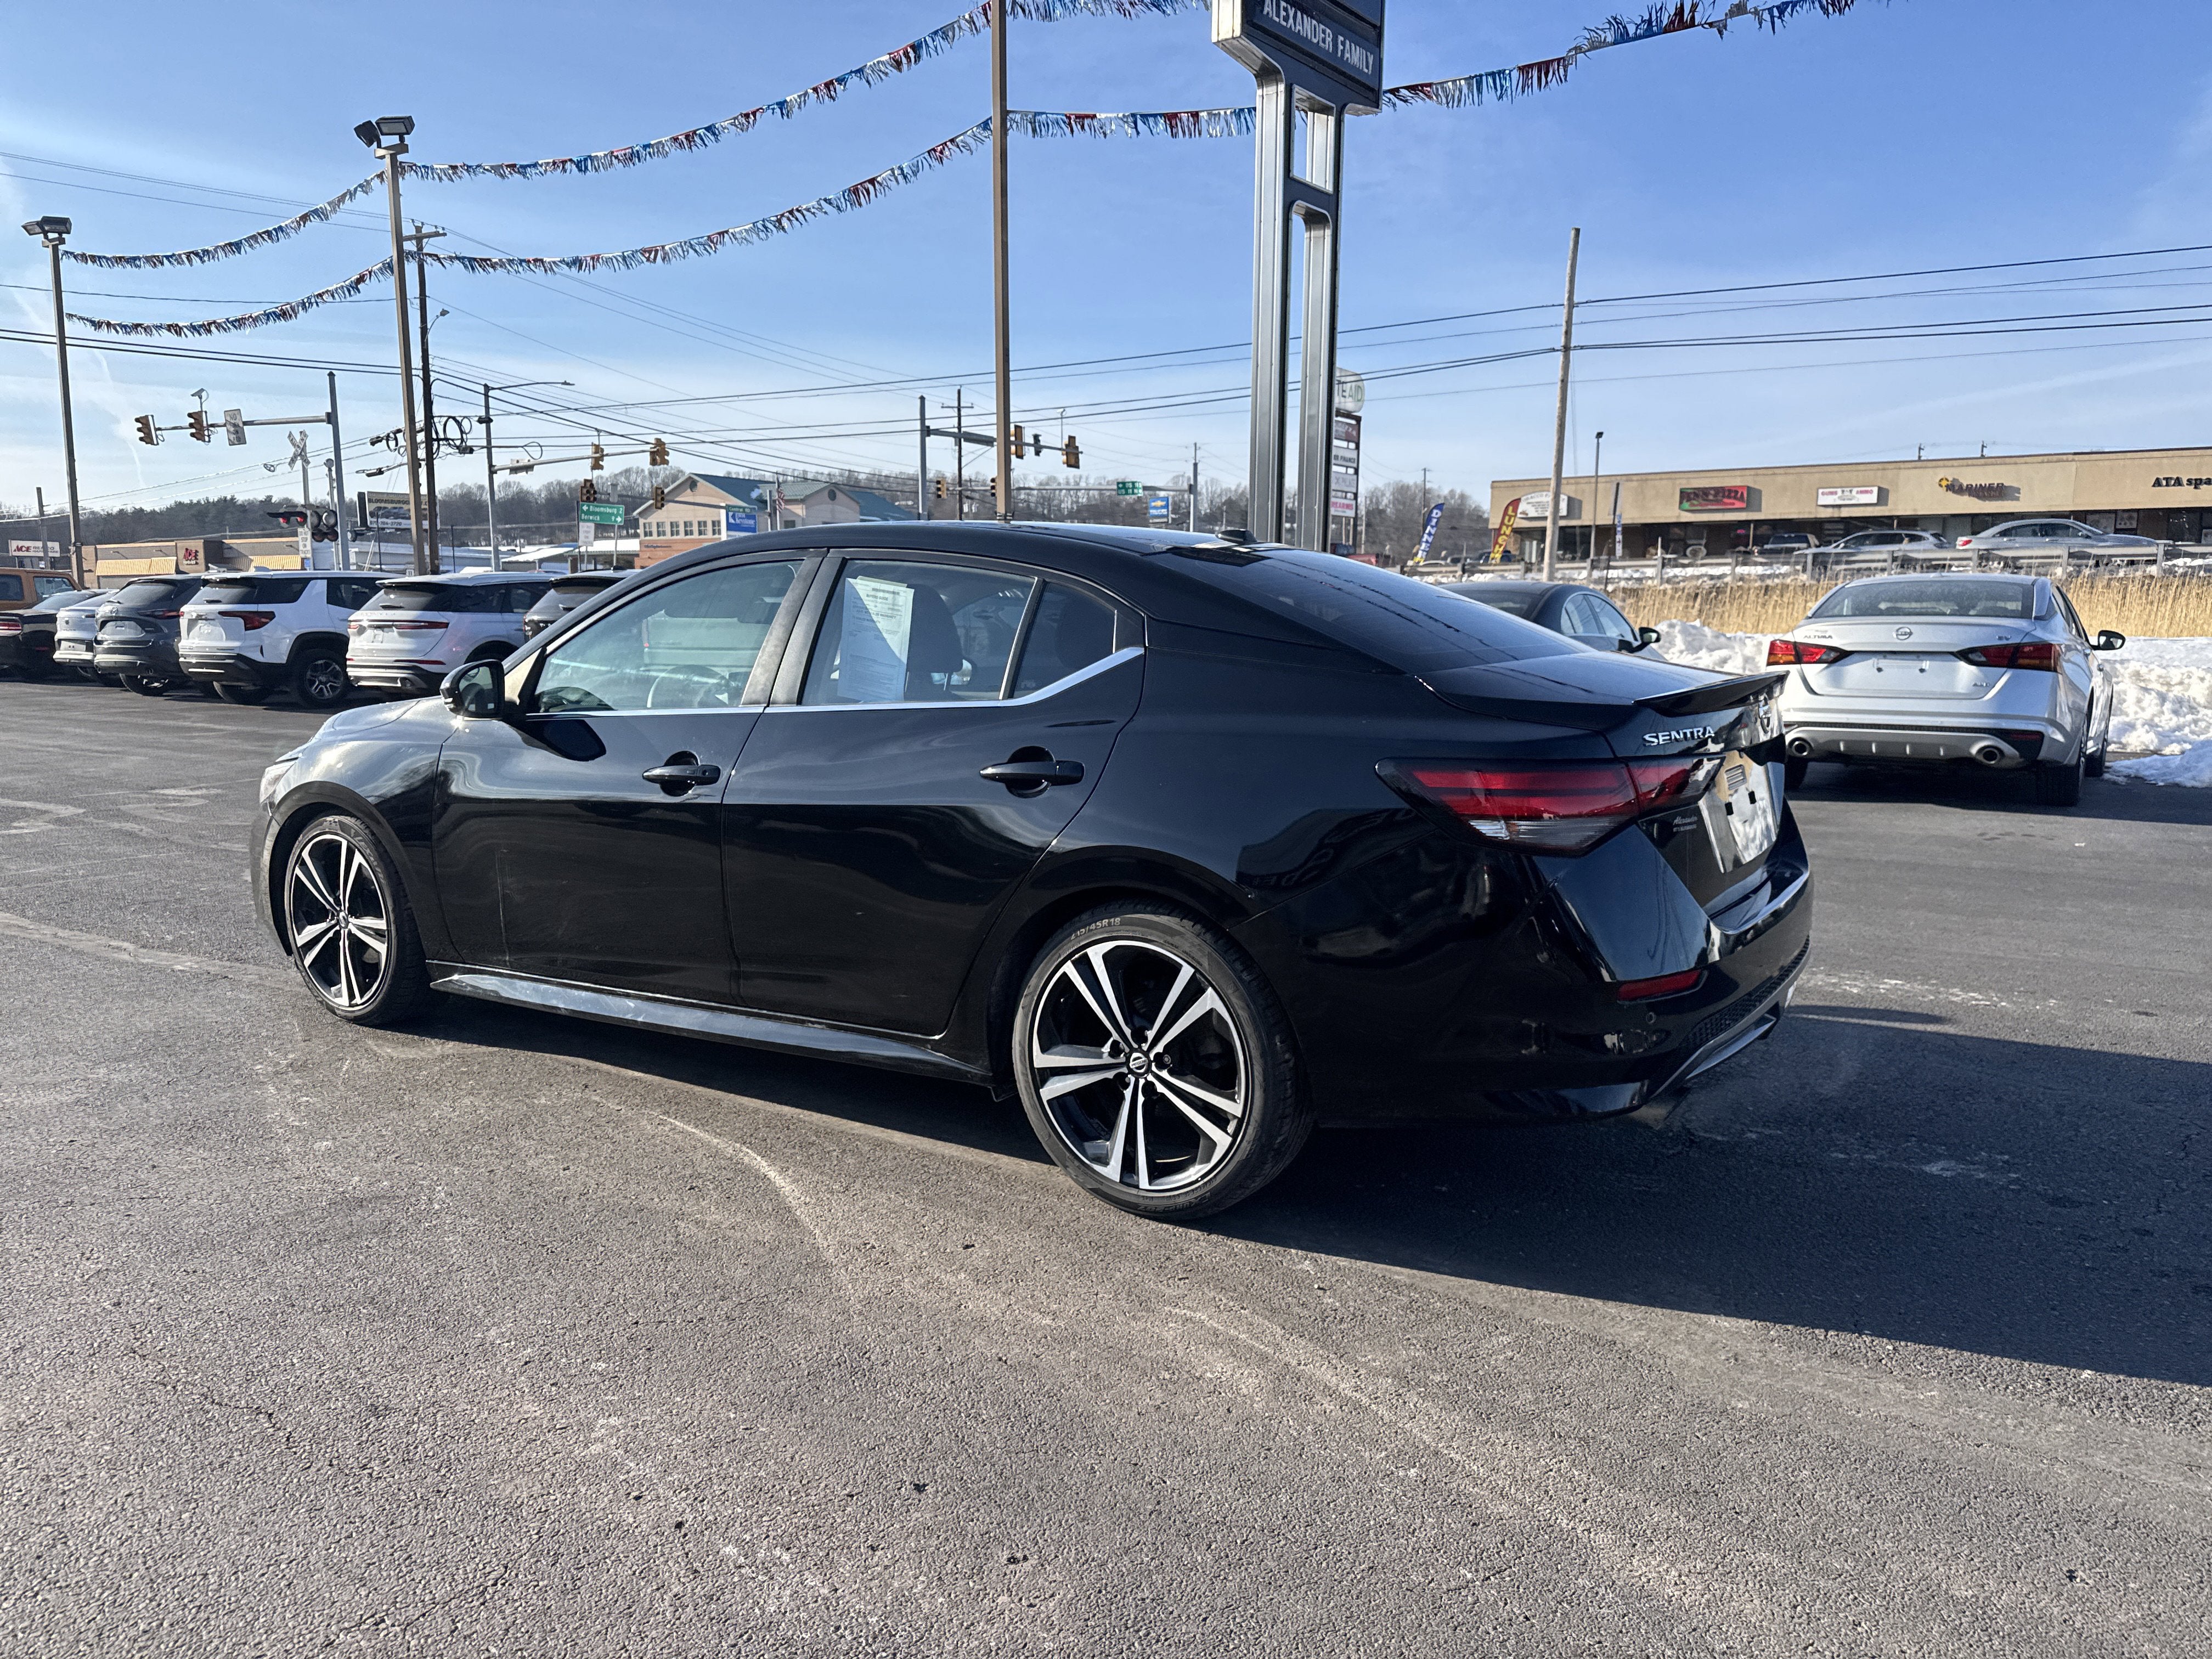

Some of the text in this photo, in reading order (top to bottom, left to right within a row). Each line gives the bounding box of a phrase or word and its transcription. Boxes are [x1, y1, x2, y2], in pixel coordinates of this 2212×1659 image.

[1263, 0, 1374, 75] ALEXANDER FAMILY
[229, 413, 237, 421] NO
[2151, 476, 2185, 487] ATA
[589, 505, 617, 514] Bloomsburg
[1493, 506, 1516, 554] LUNCH
[13, 544, 31, 552] ACE
[183, 548, 198, 560] ACE
[1643, 726, 1715, 746] SENTRA
